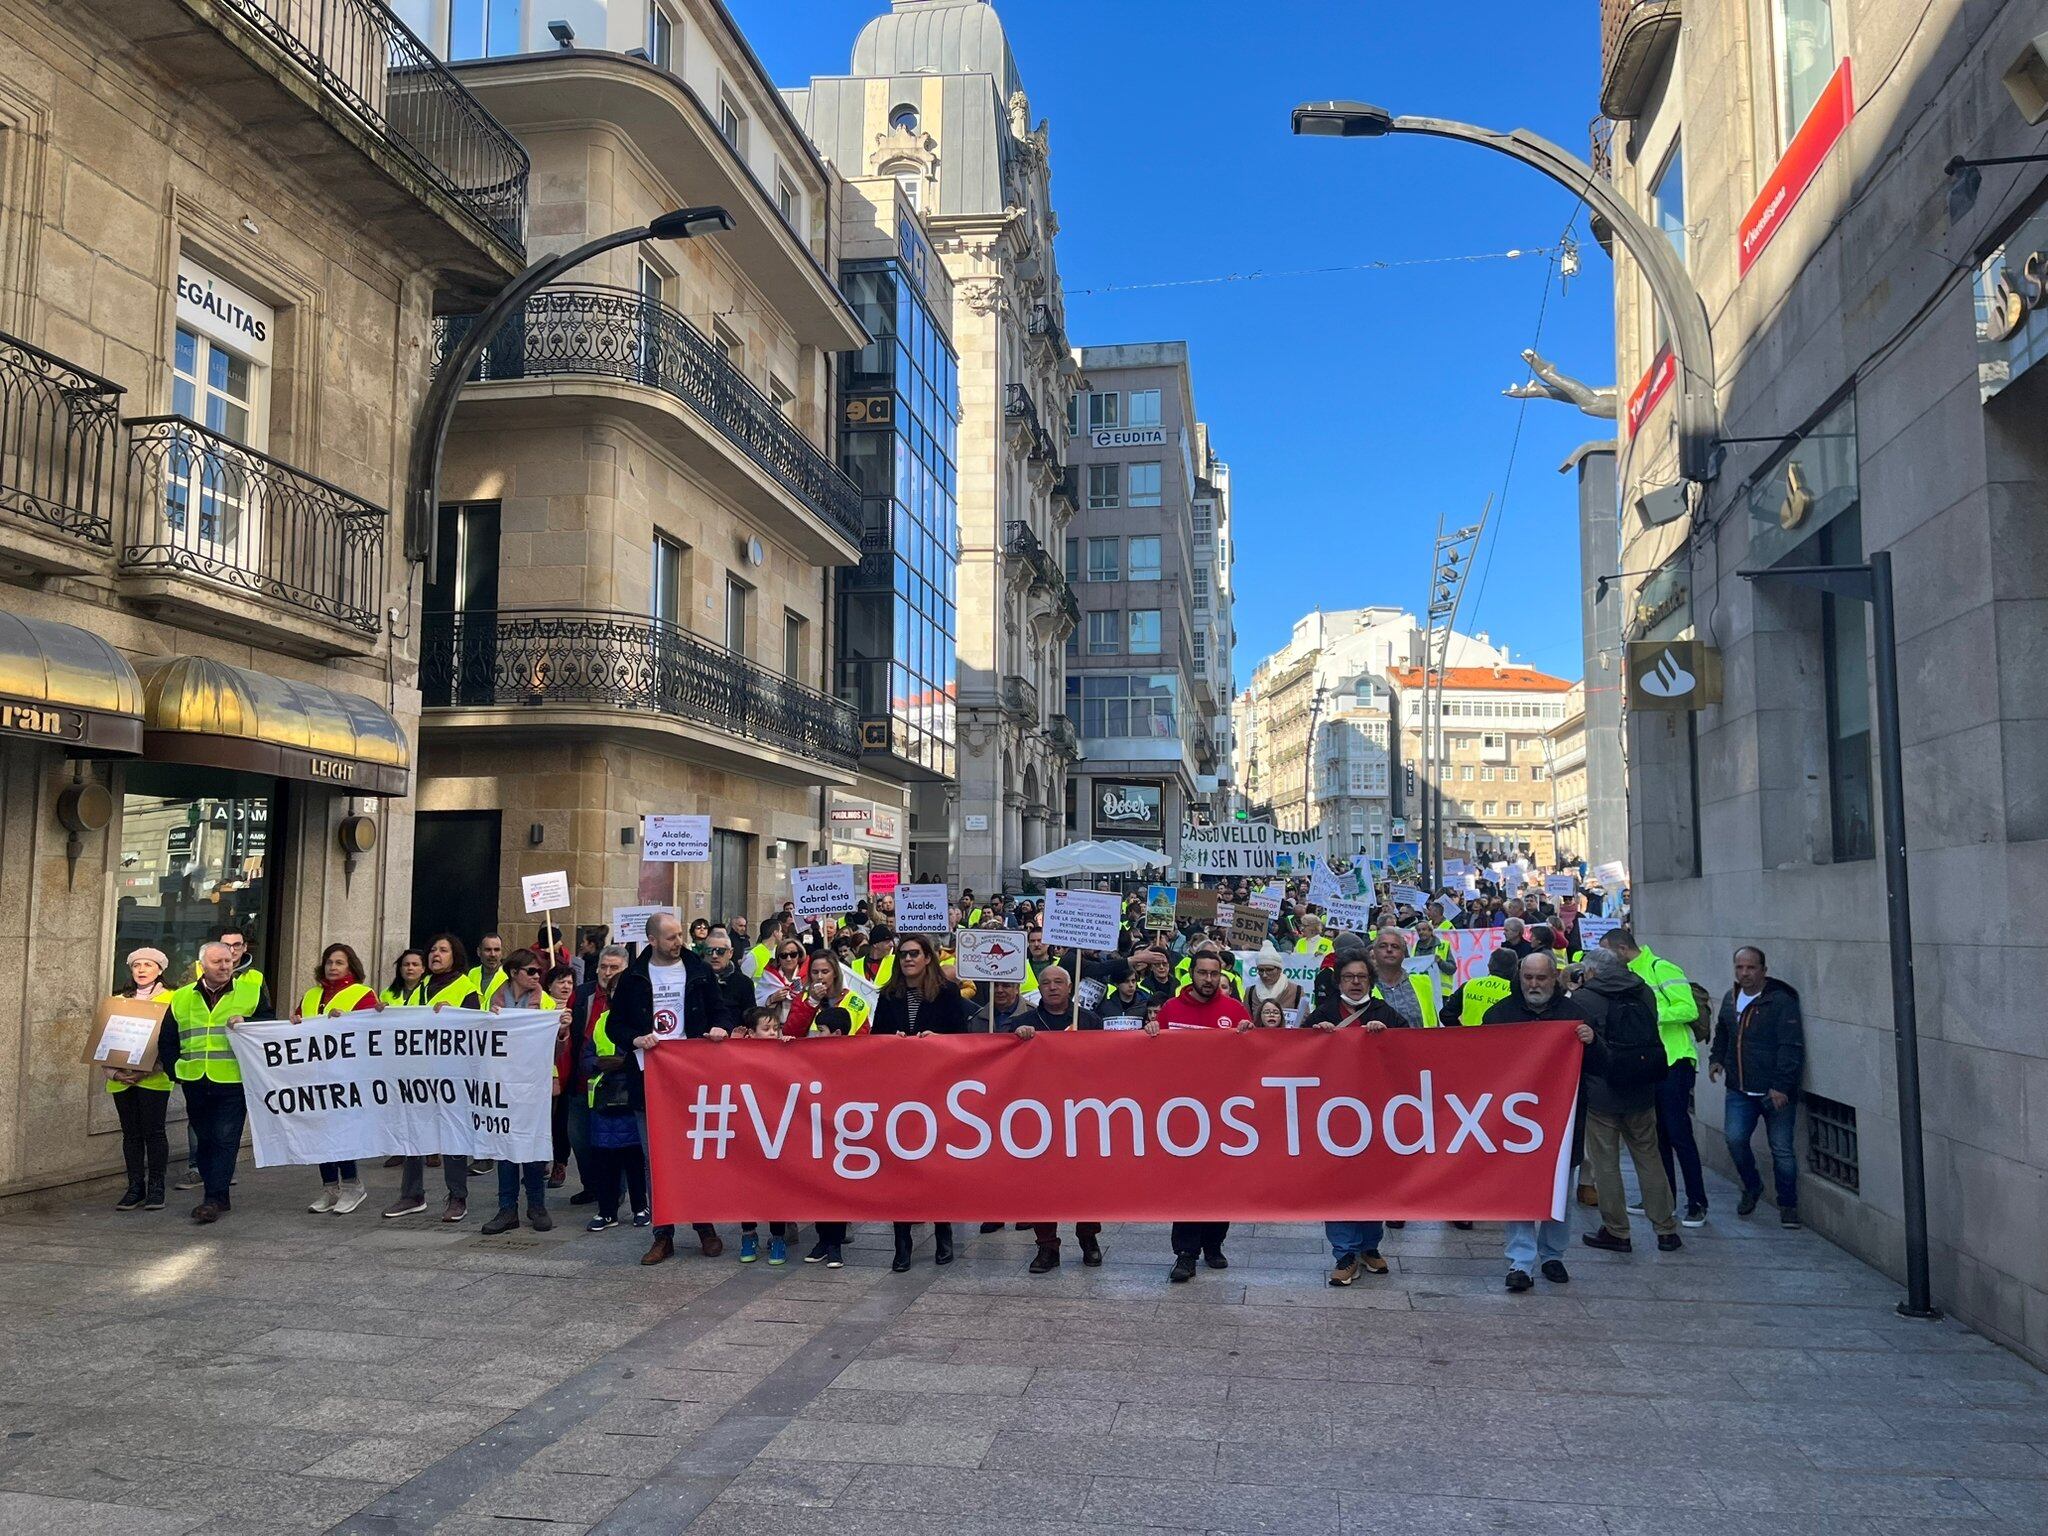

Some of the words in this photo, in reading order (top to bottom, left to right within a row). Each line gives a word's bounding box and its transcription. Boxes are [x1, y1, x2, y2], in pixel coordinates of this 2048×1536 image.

[1115, 431, 1162, 444] EUDITA
[311, 758, 354, 780] LEICHT
[662, 831, 693, 839] Alcalde,
[1181, 823, 1219, 843] CASCO
[1222, 826, 1267, 843] VELLO
[646, 840, 664, 849] Vigo
[678, 840, 708, 848] termina
[1211, 849, 1237, 868] SEN
[1244, 846, 1295, 869] TÚN
[806, 882, 841, 892] Alcalde,
[800, 893, 829, 903] Cabral
[831, 892, 849, 901] está
[798, 902, 854, 914] abandonado
[907, 902, 937, 910] Alcalde,
[908, 912, 926, 921] rural
[928, 912, 944, 921] está
[1077, 911, 1112, 920] NECESITAMOS
[898, 923, 947, 932] abandonado
[1059, 923, 1094, 931] PERTENEZCAN
[1235, 917, 1265, 933] SEN
[1328, 916, 1364, 931] A-52
[1050, 928, 1089, 936] AYUNTAMIENTO
[962, 954, 982, 963] 2022
[263, 1031, 356, 1068] BEADE
[368, 1030, 383, 1056] E
[394, 1029, 508, 1057] BEMBRIVE
[264, 1082, 362, 1115] CONTRA
[372, 1079, 388, 1105] O
[398, 1078, 455, 1105] NOVO
[464, 1078, 508, 1109] VIAL
[686, 1069, 1545, 1181] #VigoSomosTodxs
